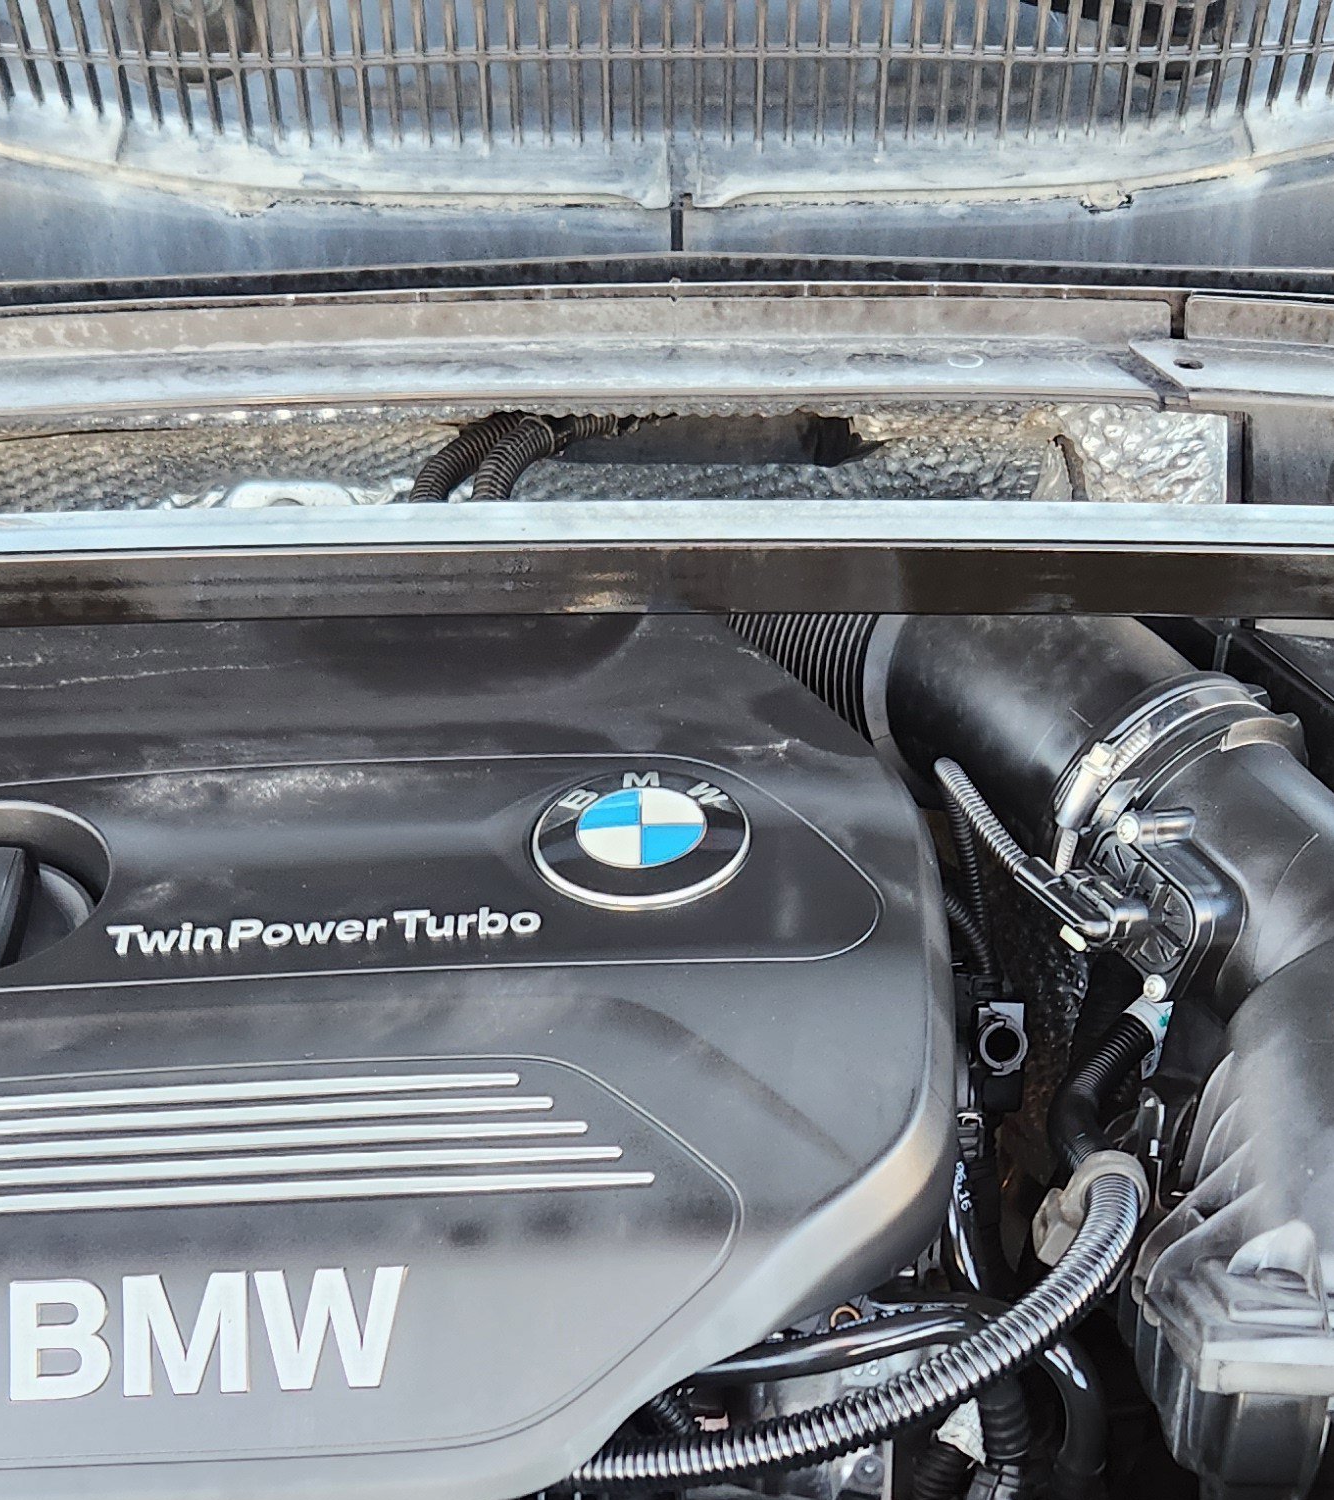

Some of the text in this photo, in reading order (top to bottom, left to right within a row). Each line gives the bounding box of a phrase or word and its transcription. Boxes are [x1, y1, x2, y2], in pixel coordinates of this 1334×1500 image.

[558, 771, 729, 811] BMW
[105, 906, 543, 957] TwinPower Turbo
[8, 1264, 409, 1402] BMW
